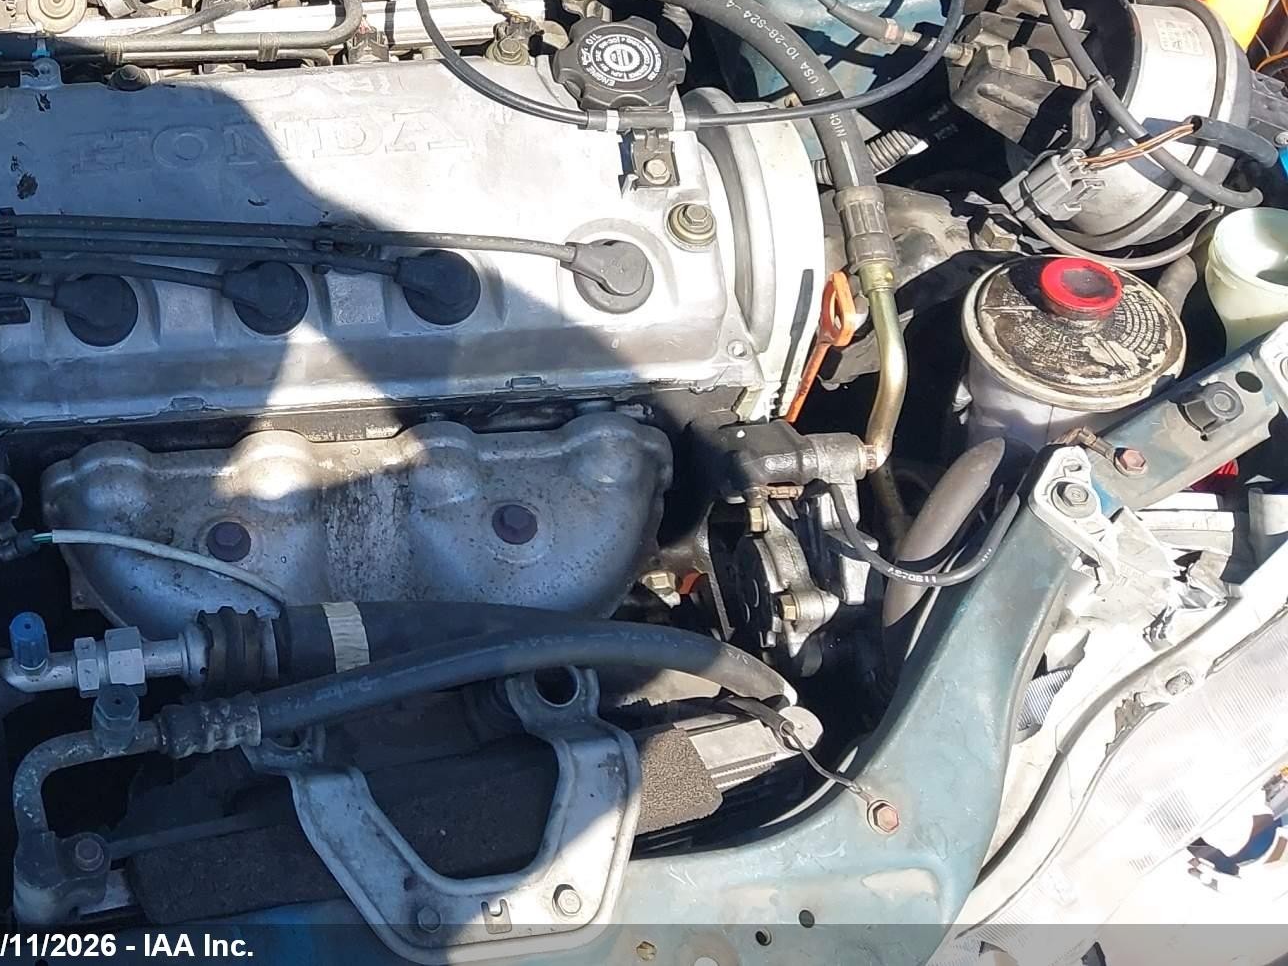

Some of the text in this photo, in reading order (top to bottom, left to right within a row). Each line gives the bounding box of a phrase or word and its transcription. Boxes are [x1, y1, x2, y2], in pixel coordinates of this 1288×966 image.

[585, 33, 616, 87] ENGINE OIL
[797, 60, 820, 84] USA
[70, 110, 472, 176] HONDA
